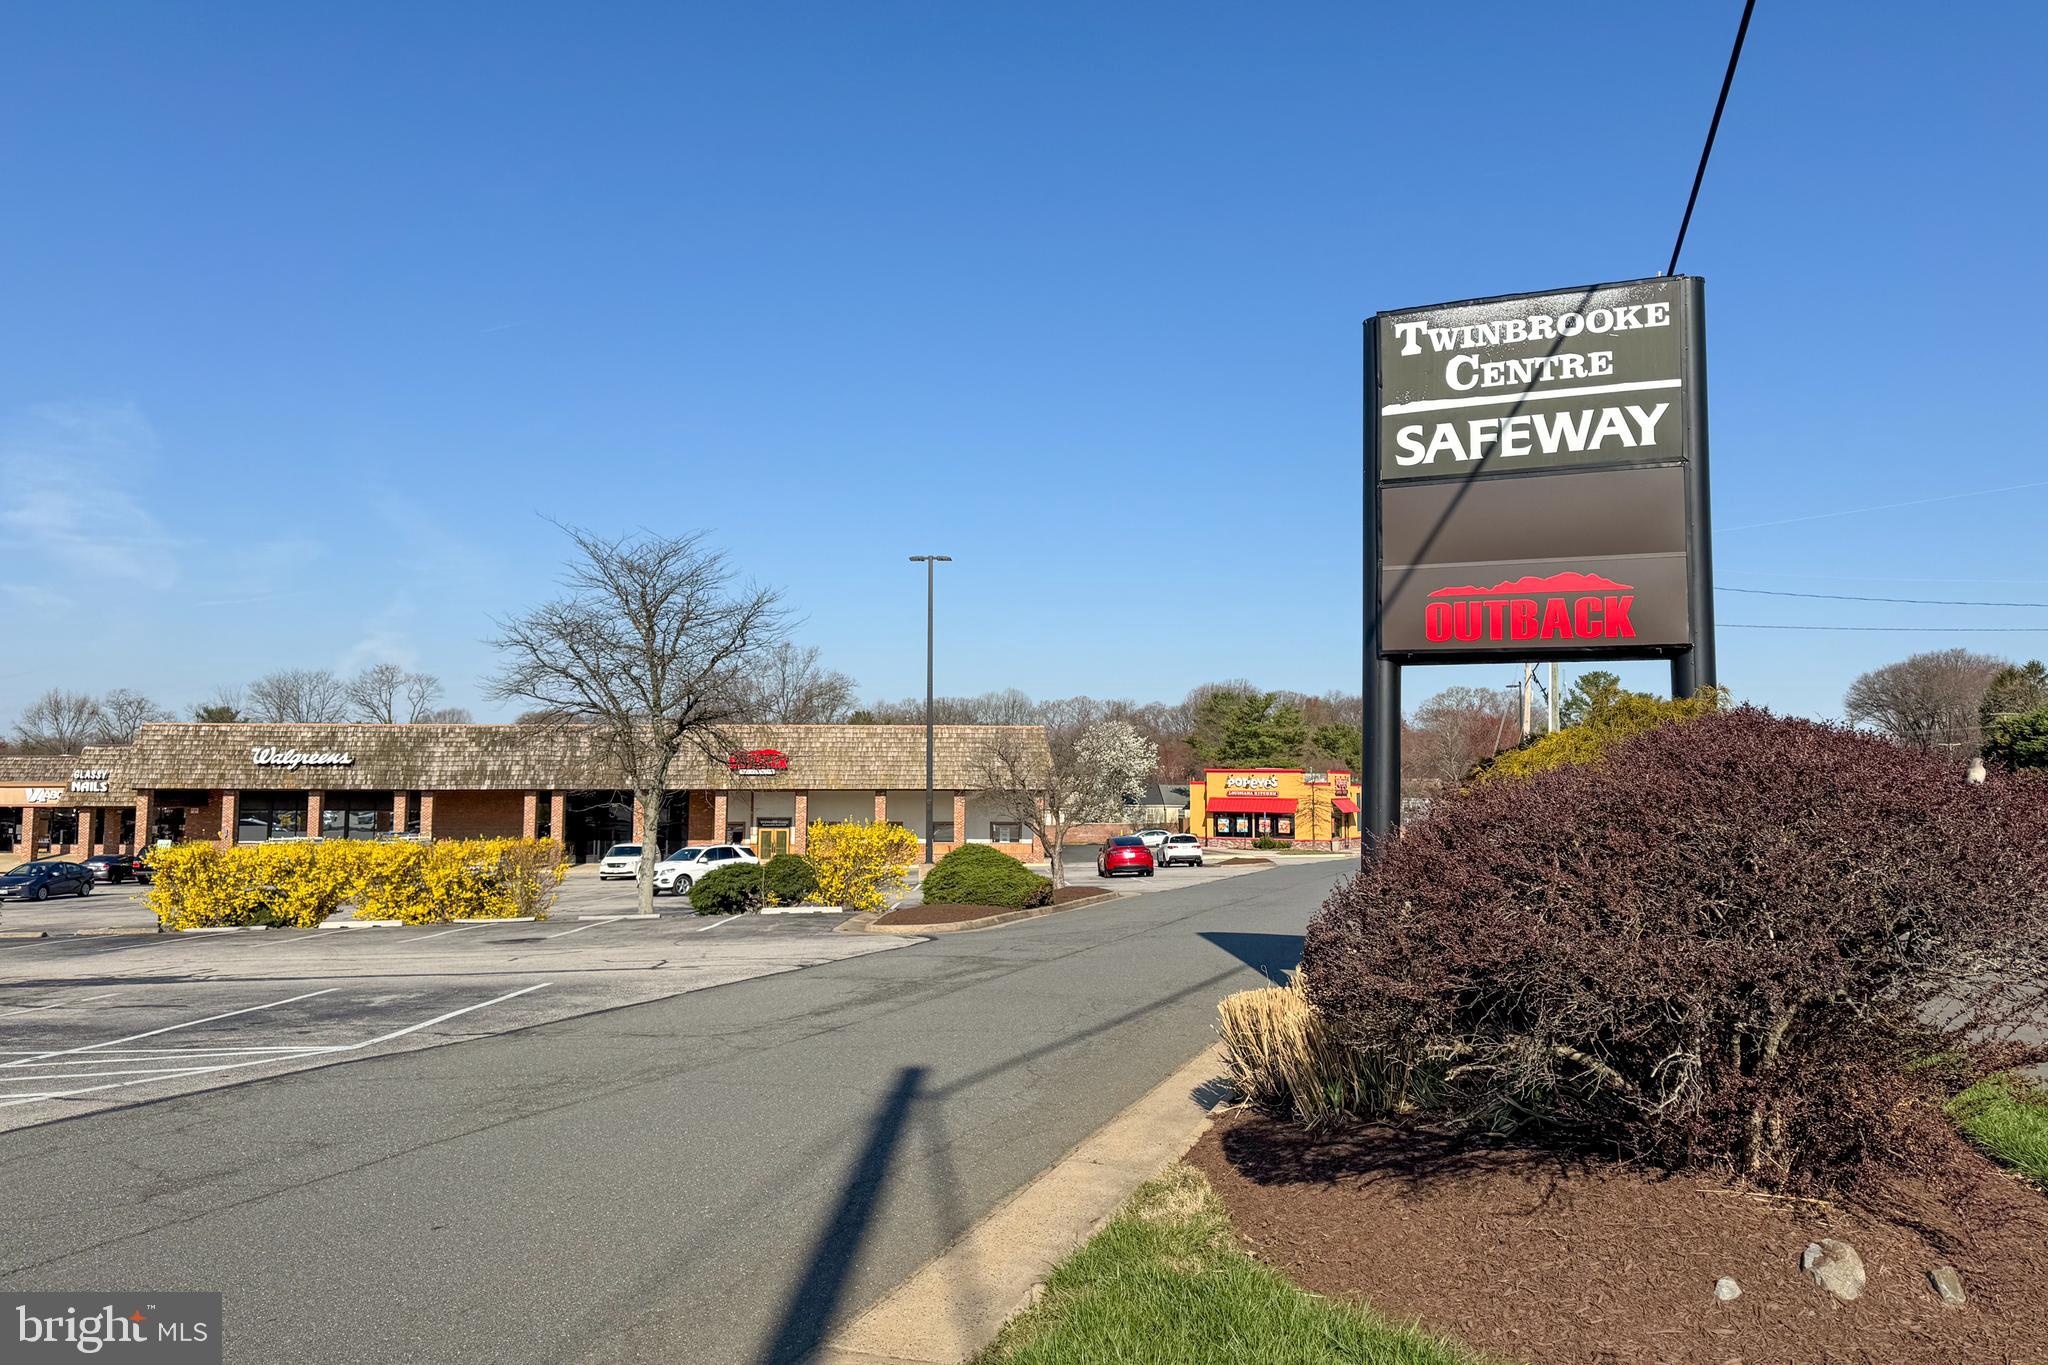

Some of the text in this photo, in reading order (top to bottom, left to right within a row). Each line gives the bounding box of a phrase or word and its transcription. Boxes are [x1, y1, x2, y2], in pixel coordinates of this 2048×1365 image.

[1394, 302, 1670, 356] TWINBROOKE
[1445, 351, 1613, 391] CENTRE
[1395, 403, 1670, 466] SAFEWAY
[1425, 596, 1637, 643] OUTBACK
[73, 769, 109, 780] GLASSY
[251, 746, 354, 770] Walgreens
[71, 781, 109, 792] NAILS
